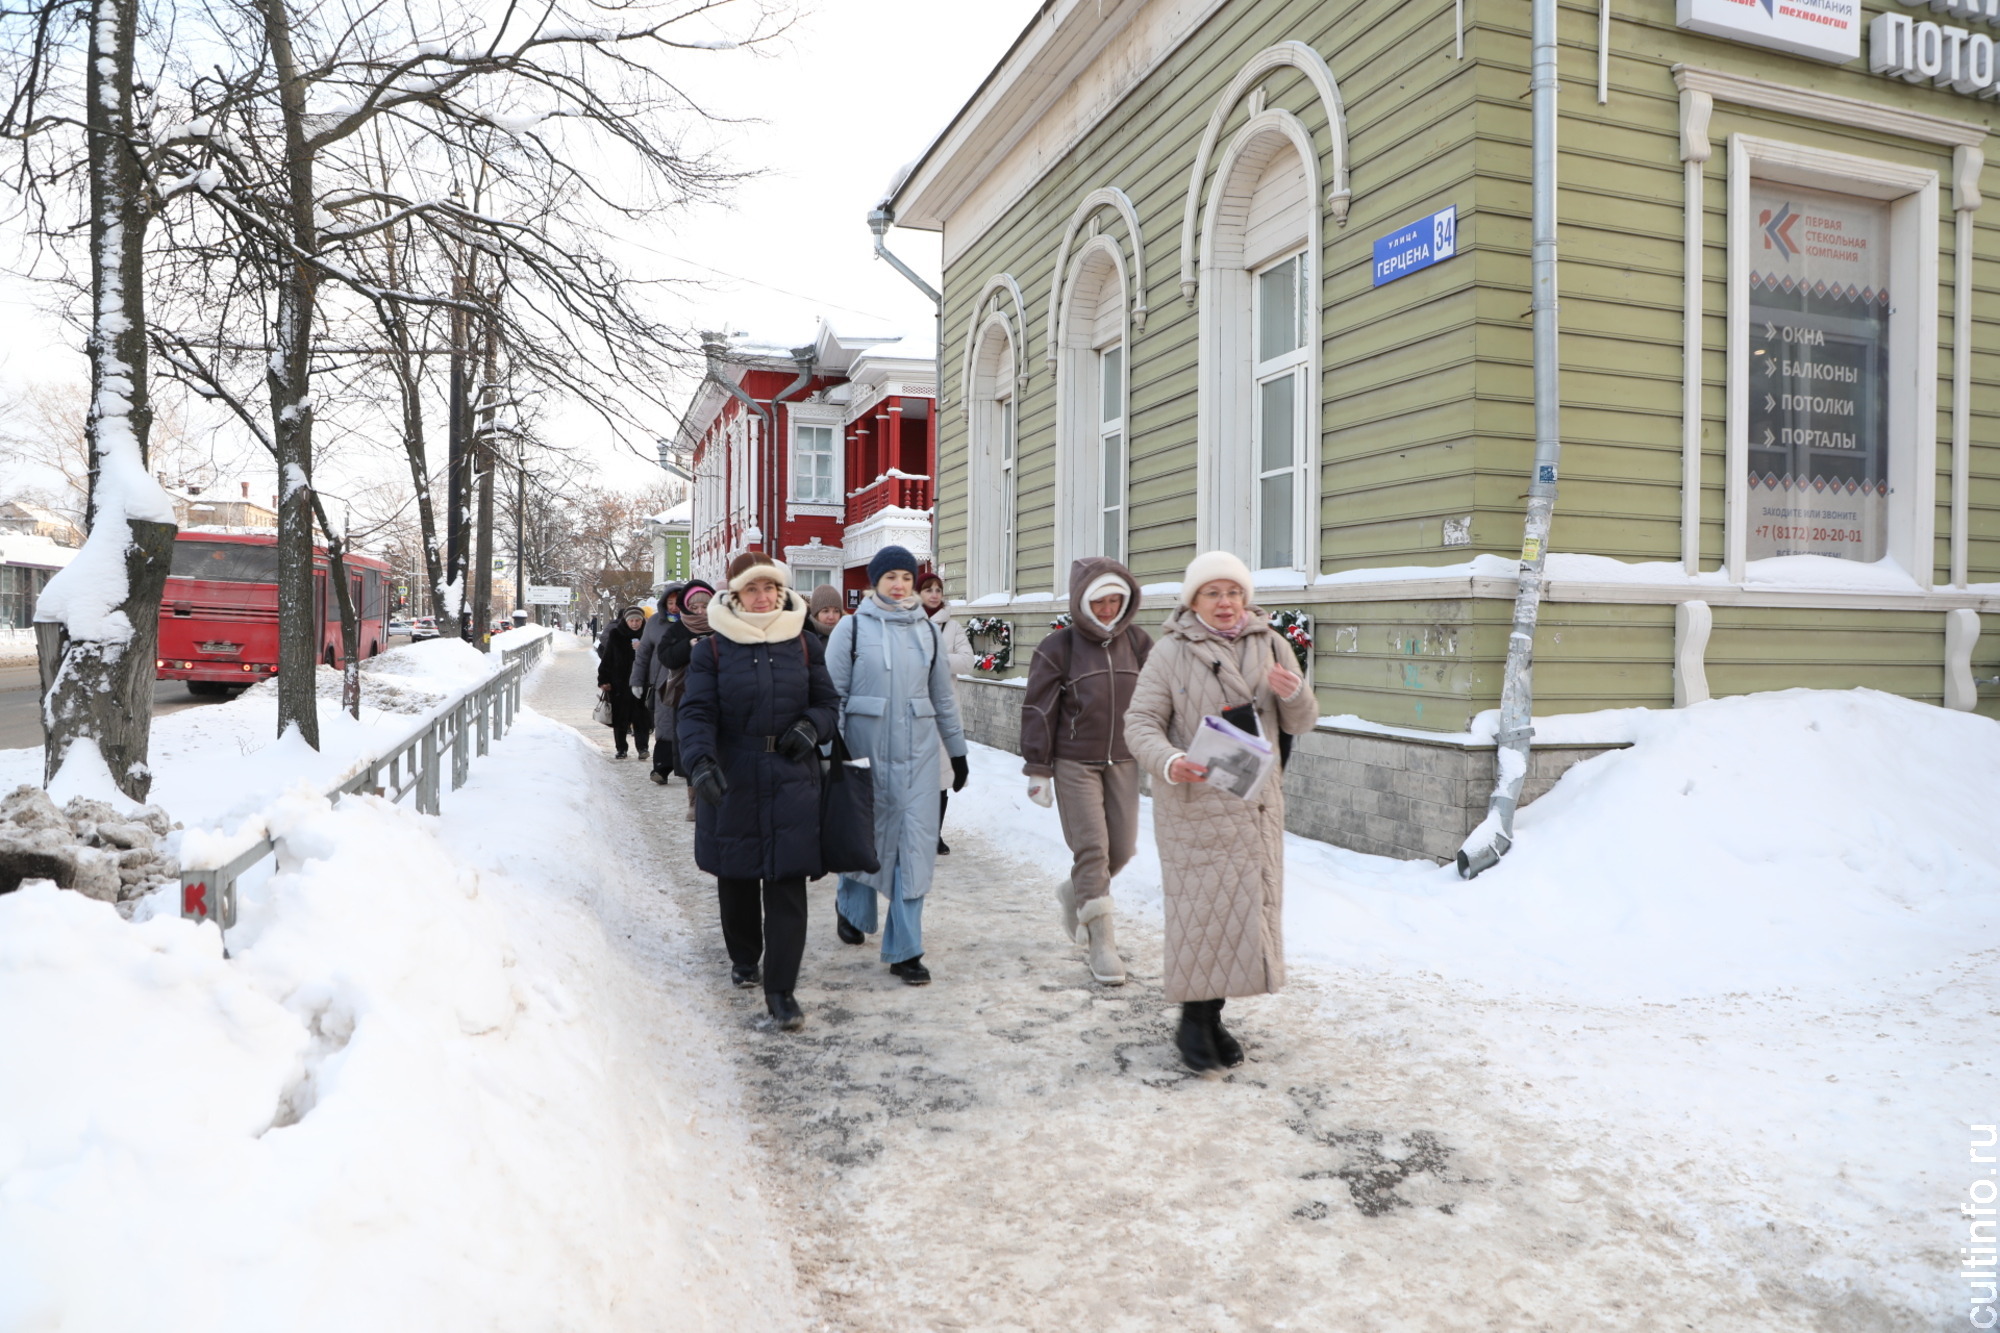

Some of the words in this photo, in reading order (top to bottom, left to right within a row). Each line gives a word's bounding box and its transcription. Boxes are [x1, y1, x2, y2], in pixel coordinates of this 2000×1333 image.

[1778, 5, 1849, 30] технологии
[1884, 11, 2000, 92] ПОТО
[1435, 216, 1452, 252] 34
[1805, 215, 1842, 231] ПЕРВАЯ
[1388, 230, 1418, 250] УЛИЦА
[1805, 230, 1867, 250] СТЕКОЛЬНАЯ
[1377, 243, 1430, 278] ГЕРЦЕНА
[1805, 245, 1859, 263] КОМПАНИЯ
[1782, 326, 1825, 347] ОКНА
[1782, 359, 1858, 384] БАЛКОНЫ
[1781, 394, 1854, 417] ПОТОЛКИ
[1781, 427, 1856, 450] ПОРТАЛЫ
[1762, 507, 1802, 519] ЗАХОДИТЕ
[1804, 508, 1821, 519] ИЛИ
[1822, 510, 1857, 521] ЗВОНИТЕ
[1755, 525, 1769, 538] +7
[1772, 524, 1810, 543] (8172)
[1812, 527, 1862, 543] 20-20-01
